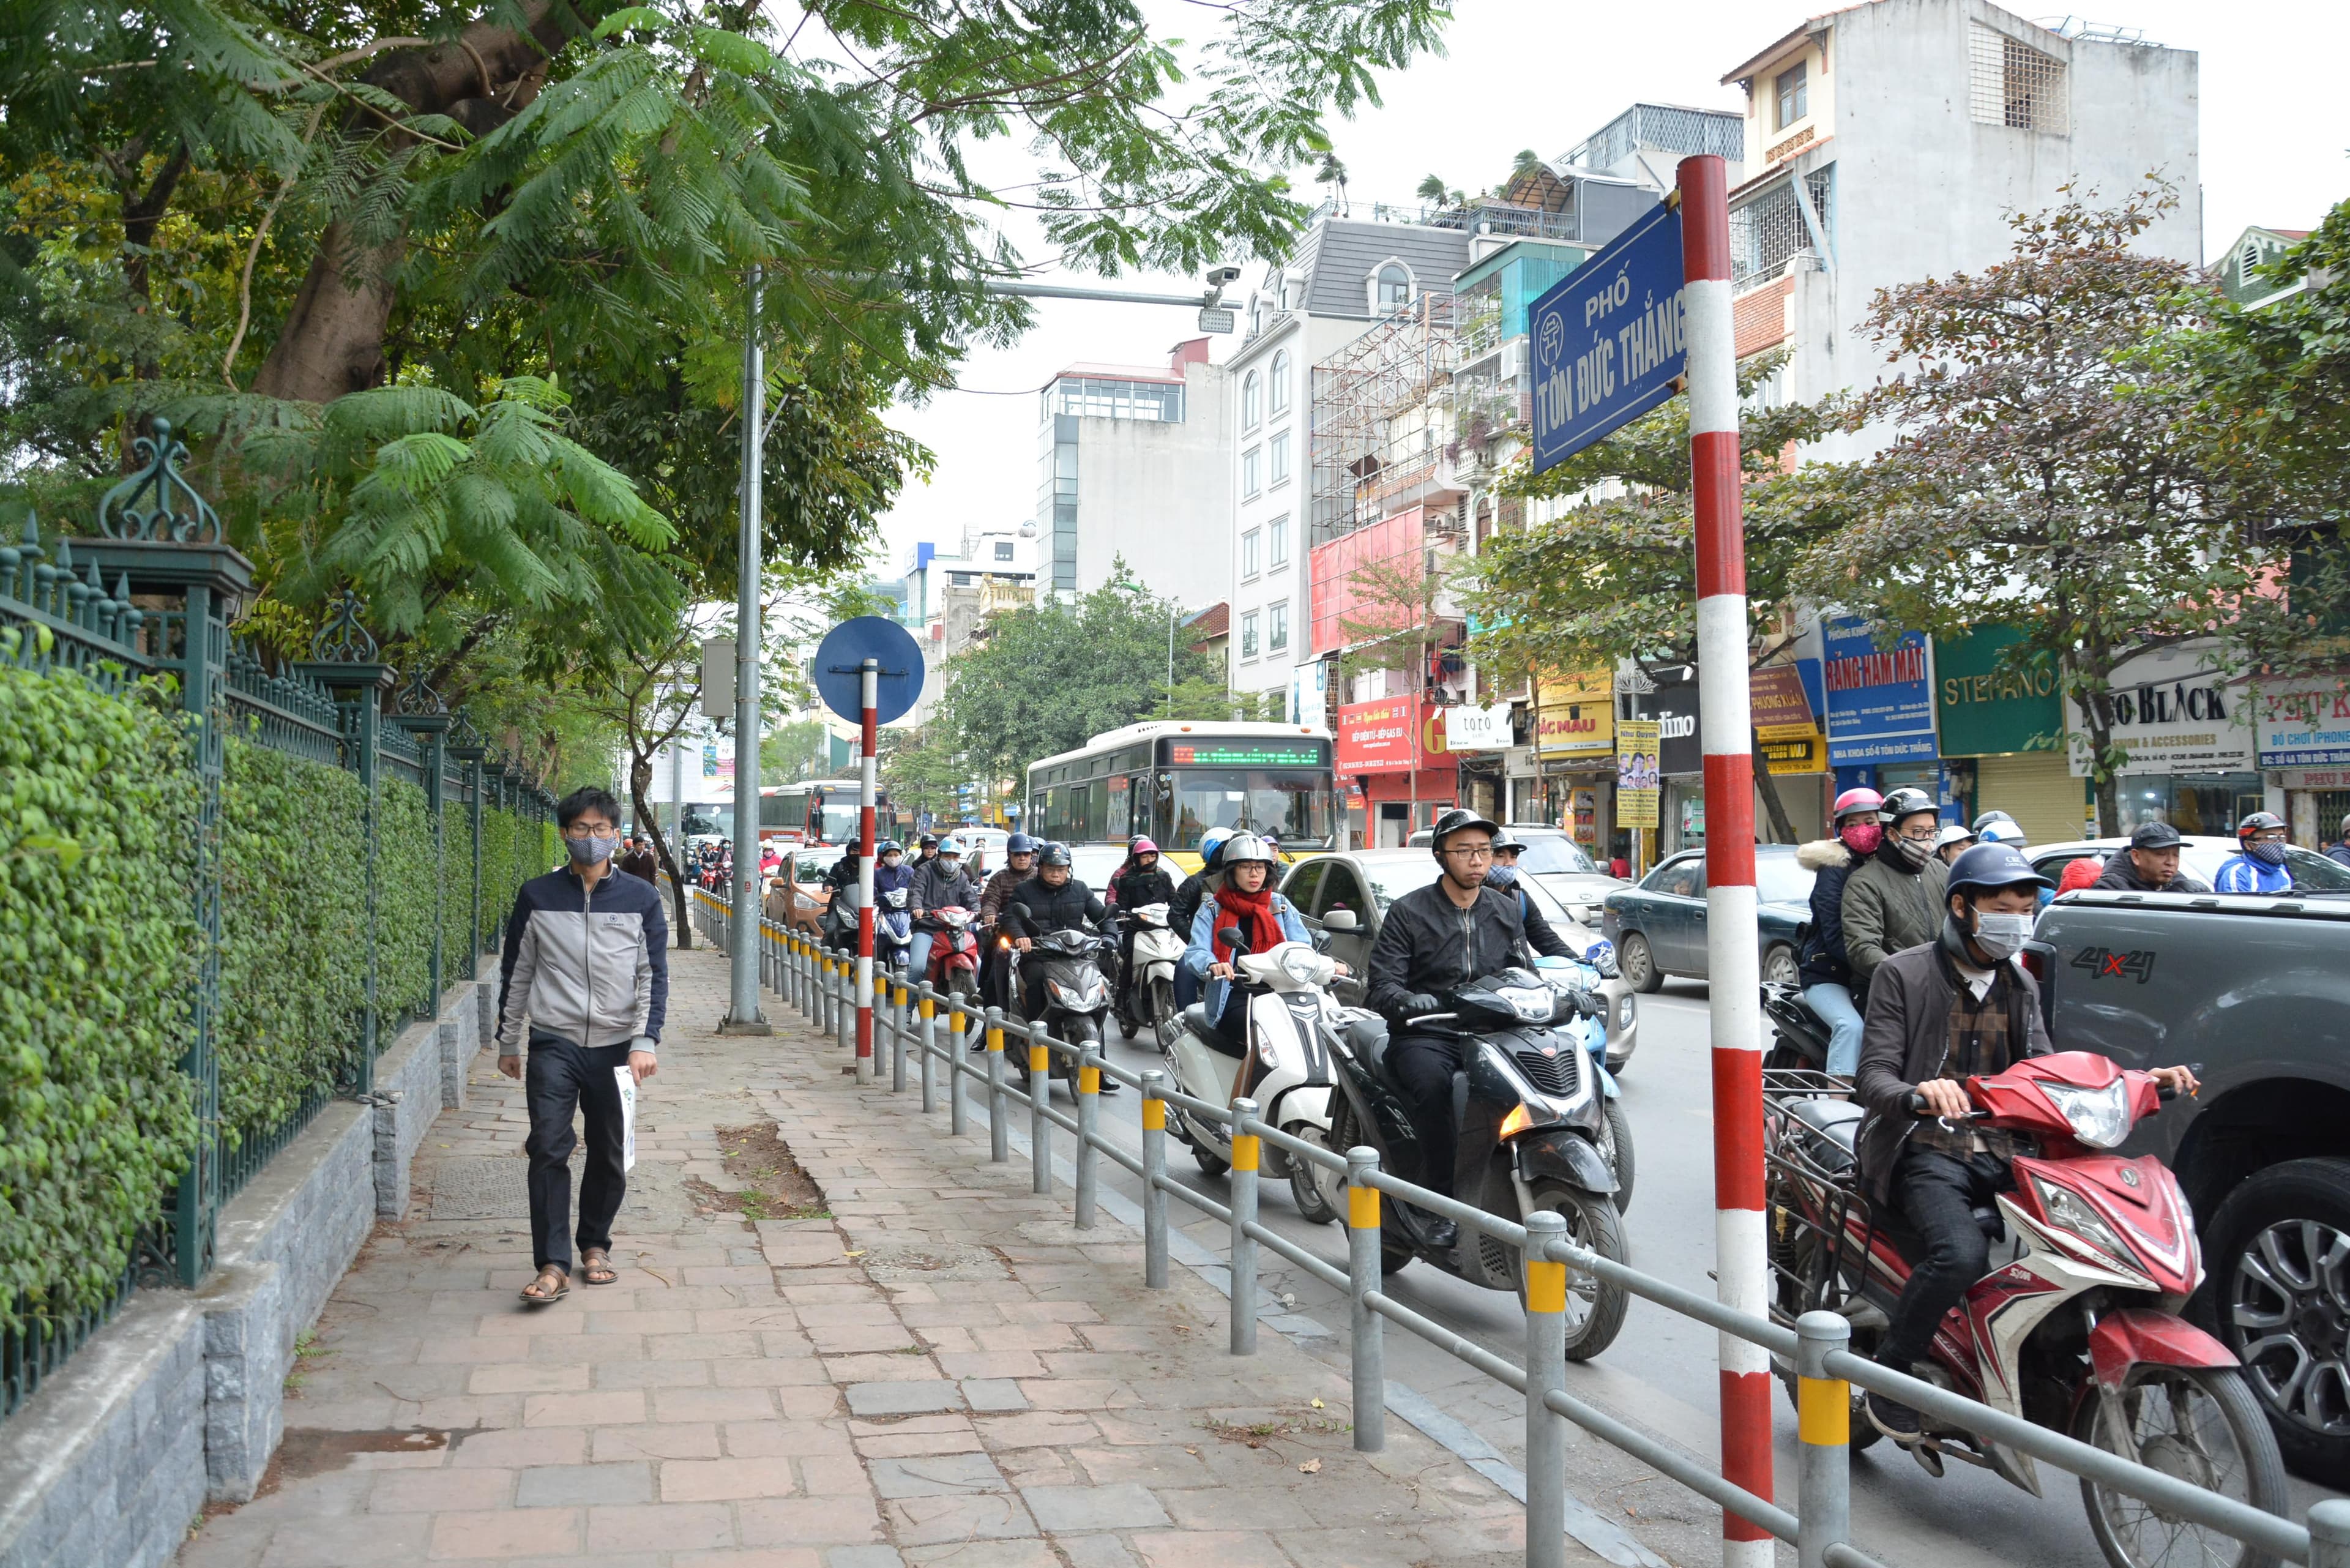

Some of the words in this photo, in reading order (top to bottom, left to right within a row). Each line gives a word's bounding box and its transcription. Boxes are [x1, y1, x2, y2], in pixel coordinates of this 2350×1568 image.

[1586, 259, 1630, 327] PHỐ
[1538, 365, 1573, 436] TÔN
[1576, 329, 1614, 414] ĐỨC
[1619, 289, 1687, 387] THẮNG
[1826, 651, 1863, 692] RĂNG
[1863, 646, 1895, 687] HÀM
[1896, 640, 1925, 689] MẶT
[1464, 717, 1491, 730] toro
[1538, 717, 1556, 735] ẮC
[1833, 750, 1847, 759] NHA
[1848, 748, 1865, 758] KHOA
[1866, 744, 1874, 756] SỐ
[1874, 745, 1880, 756] 4
[1881, 744, 1894, 756] TÔN
[1909, 739, 1933, 753] THẮNG
[2151, 733, 2217, 748] ACCESSORIES
[2070, 946, 2156, 984] 4x4
